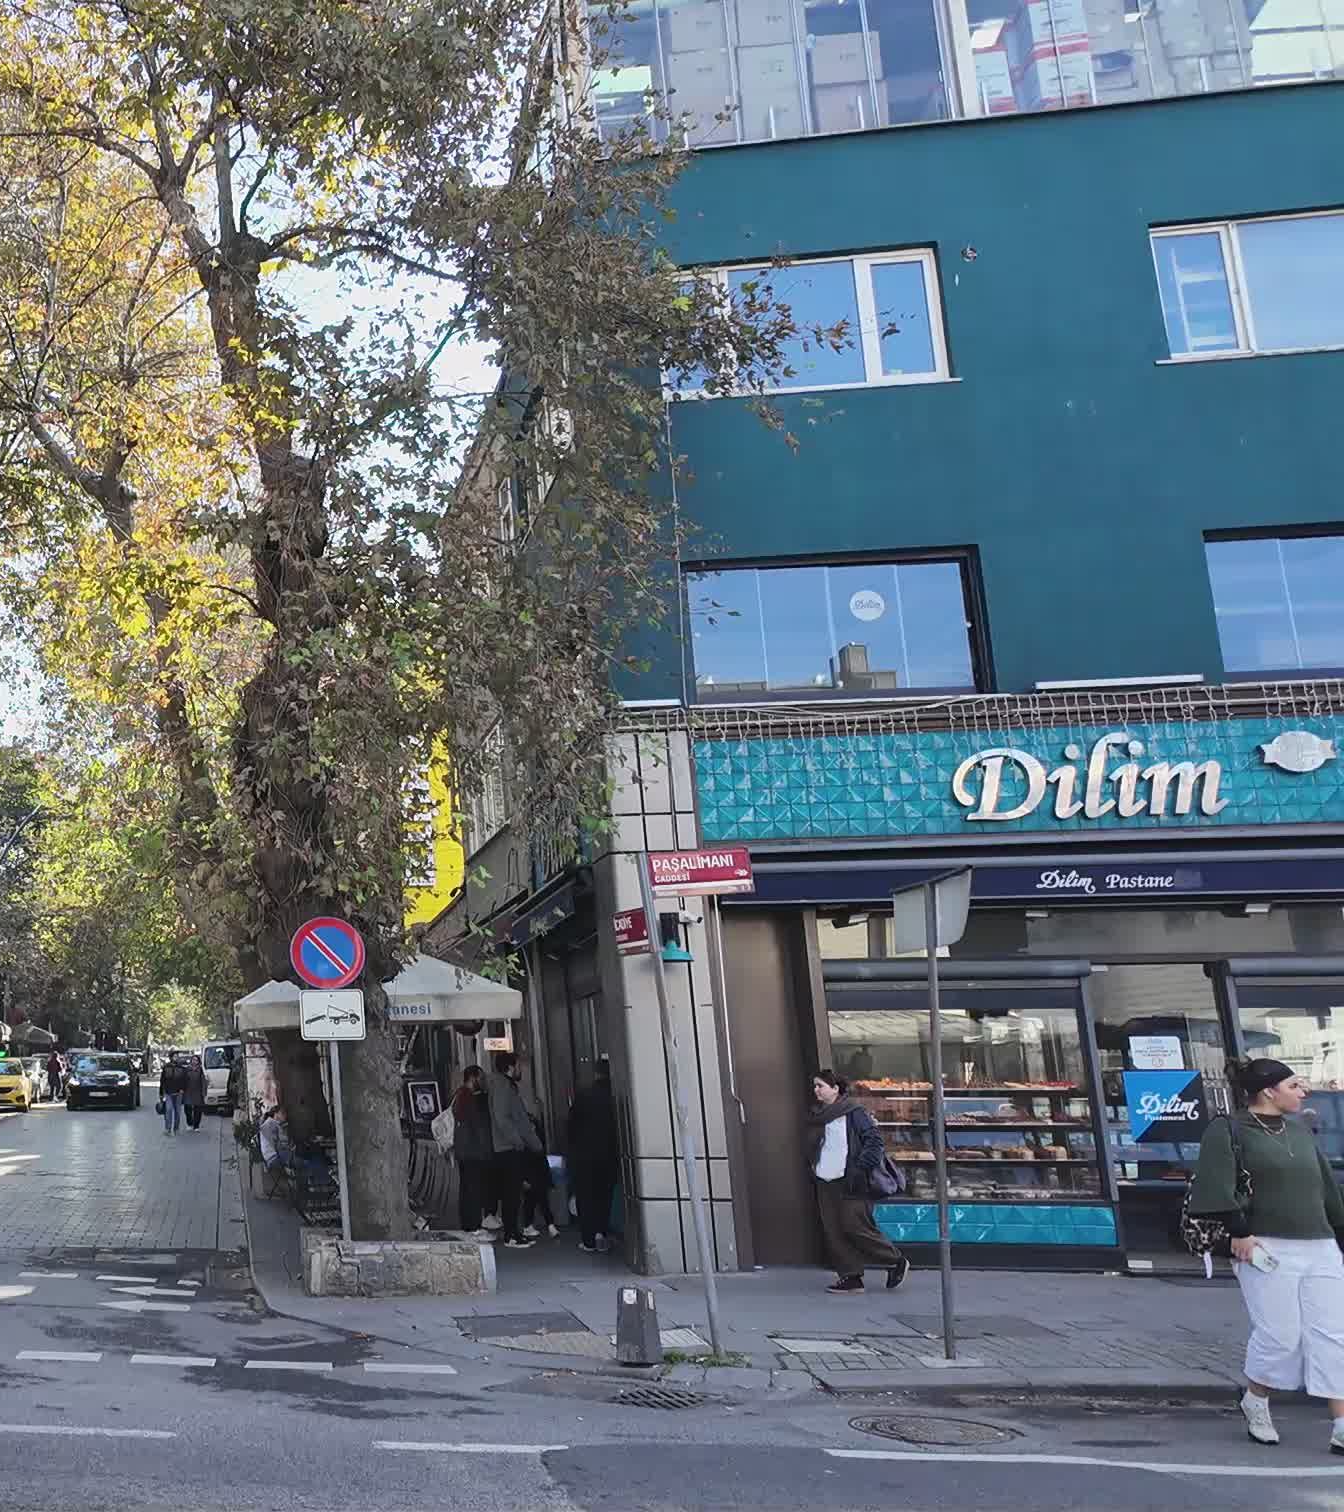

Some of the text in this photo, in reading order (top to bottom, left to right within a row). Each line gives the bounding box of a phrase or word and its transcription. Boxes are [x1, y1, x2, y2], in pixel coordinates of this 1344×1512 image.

[952, 732, 1230, 821] Dilim
[1036, 870, 1175, 894] Dilim Pastane
[1136, 1094, 1200, 1120] Dilim
